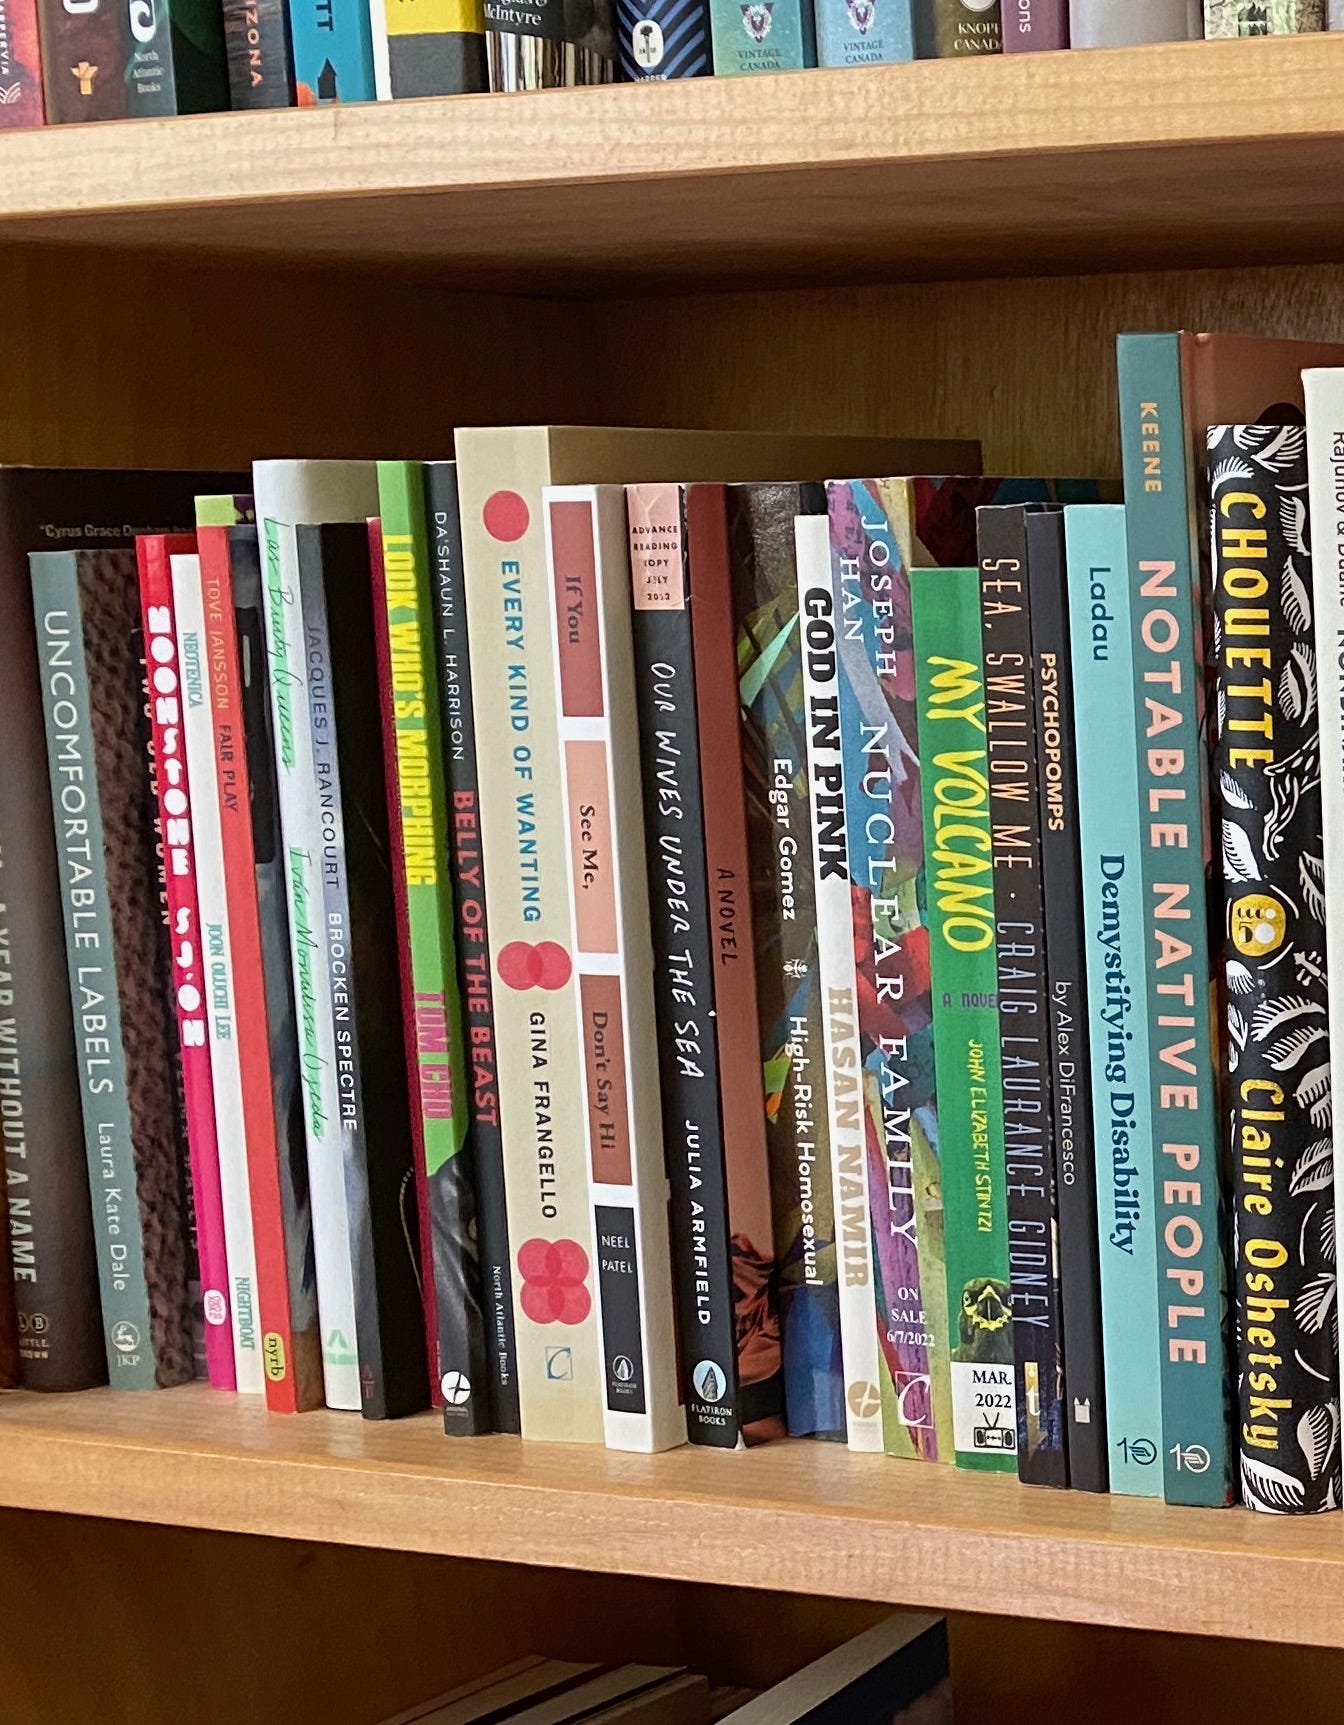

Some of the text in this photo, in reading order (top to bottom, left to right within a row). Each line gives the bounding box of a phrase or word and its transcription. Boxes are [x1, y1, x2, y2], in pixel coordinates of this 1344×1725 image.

[843, 41, 883, 51] VINTAGE
[845, 53, 883, 62] CANADA
[1140, 402, 1162, 492] KEENE
[434, 512, 464, 761] DA'SHAUN L. HARRISON
[839, 556, 863, 642] HAN
[861, 515, 895, 677] JOSEPH
[1088, 567, 1111, 661] Ladau
[1220, 491, 1274, 769] CHOUETTE
[306, 626, 339, 888] JACQUES J. RANCOURT
[383, 535, 437, 886] LOOK WHO'S MORPHING
[501, 561, 541, 922] EVERY KIND OF WANTING
[926, 655, 992, 953] MY VOLCANO
[1040, 653, 1065, 831] PSYCHOPOMPS
[44, 609, 113, 1095] UNCOMFORTABLE LABELS
[649, 662, 704, 1078] OUR WIVES UNDER THE SEA
[769, 759, 797, 921] Edgar Gomez
[328, 912, 357, 1131] BROCKEN SPECTRE
[1098, 854, 1140, 1255] Demystifying Disability
[1138, 561, 1206, 1364] NOTABLE NATIVE PEOPLE
[530, 1012, 558, 1219] GINA FRANGELLO
[592, 1011, 615, 1149] Don't Say Hi
[788, 1015, 823, 1285] High-Risk Homosexual
[828, 986, 869, 1288] HASAN NAMIR
[1053, 982, 1074, 1185] by Alex DiFrancesco
[98, 1123, 127, 1291] Laura Kate Dale
[601, 1235, 630, 1249] NEEL
[601, 1259, 633, 1273] PATEL
[686, 1120, 710, 1325] JULIA ARMFIELD
[897, 1287, 918, 1300] ON
[1241, 1080, 1292, 1451] Claire Oshetsky
[887, 1331, 935, 1347] 6/7/2022
[891, 1309, 927, 1325] SALE
[972, 1369, 1011, 1385] MAR.
[974, 1393, 1012, 1409] 2022
